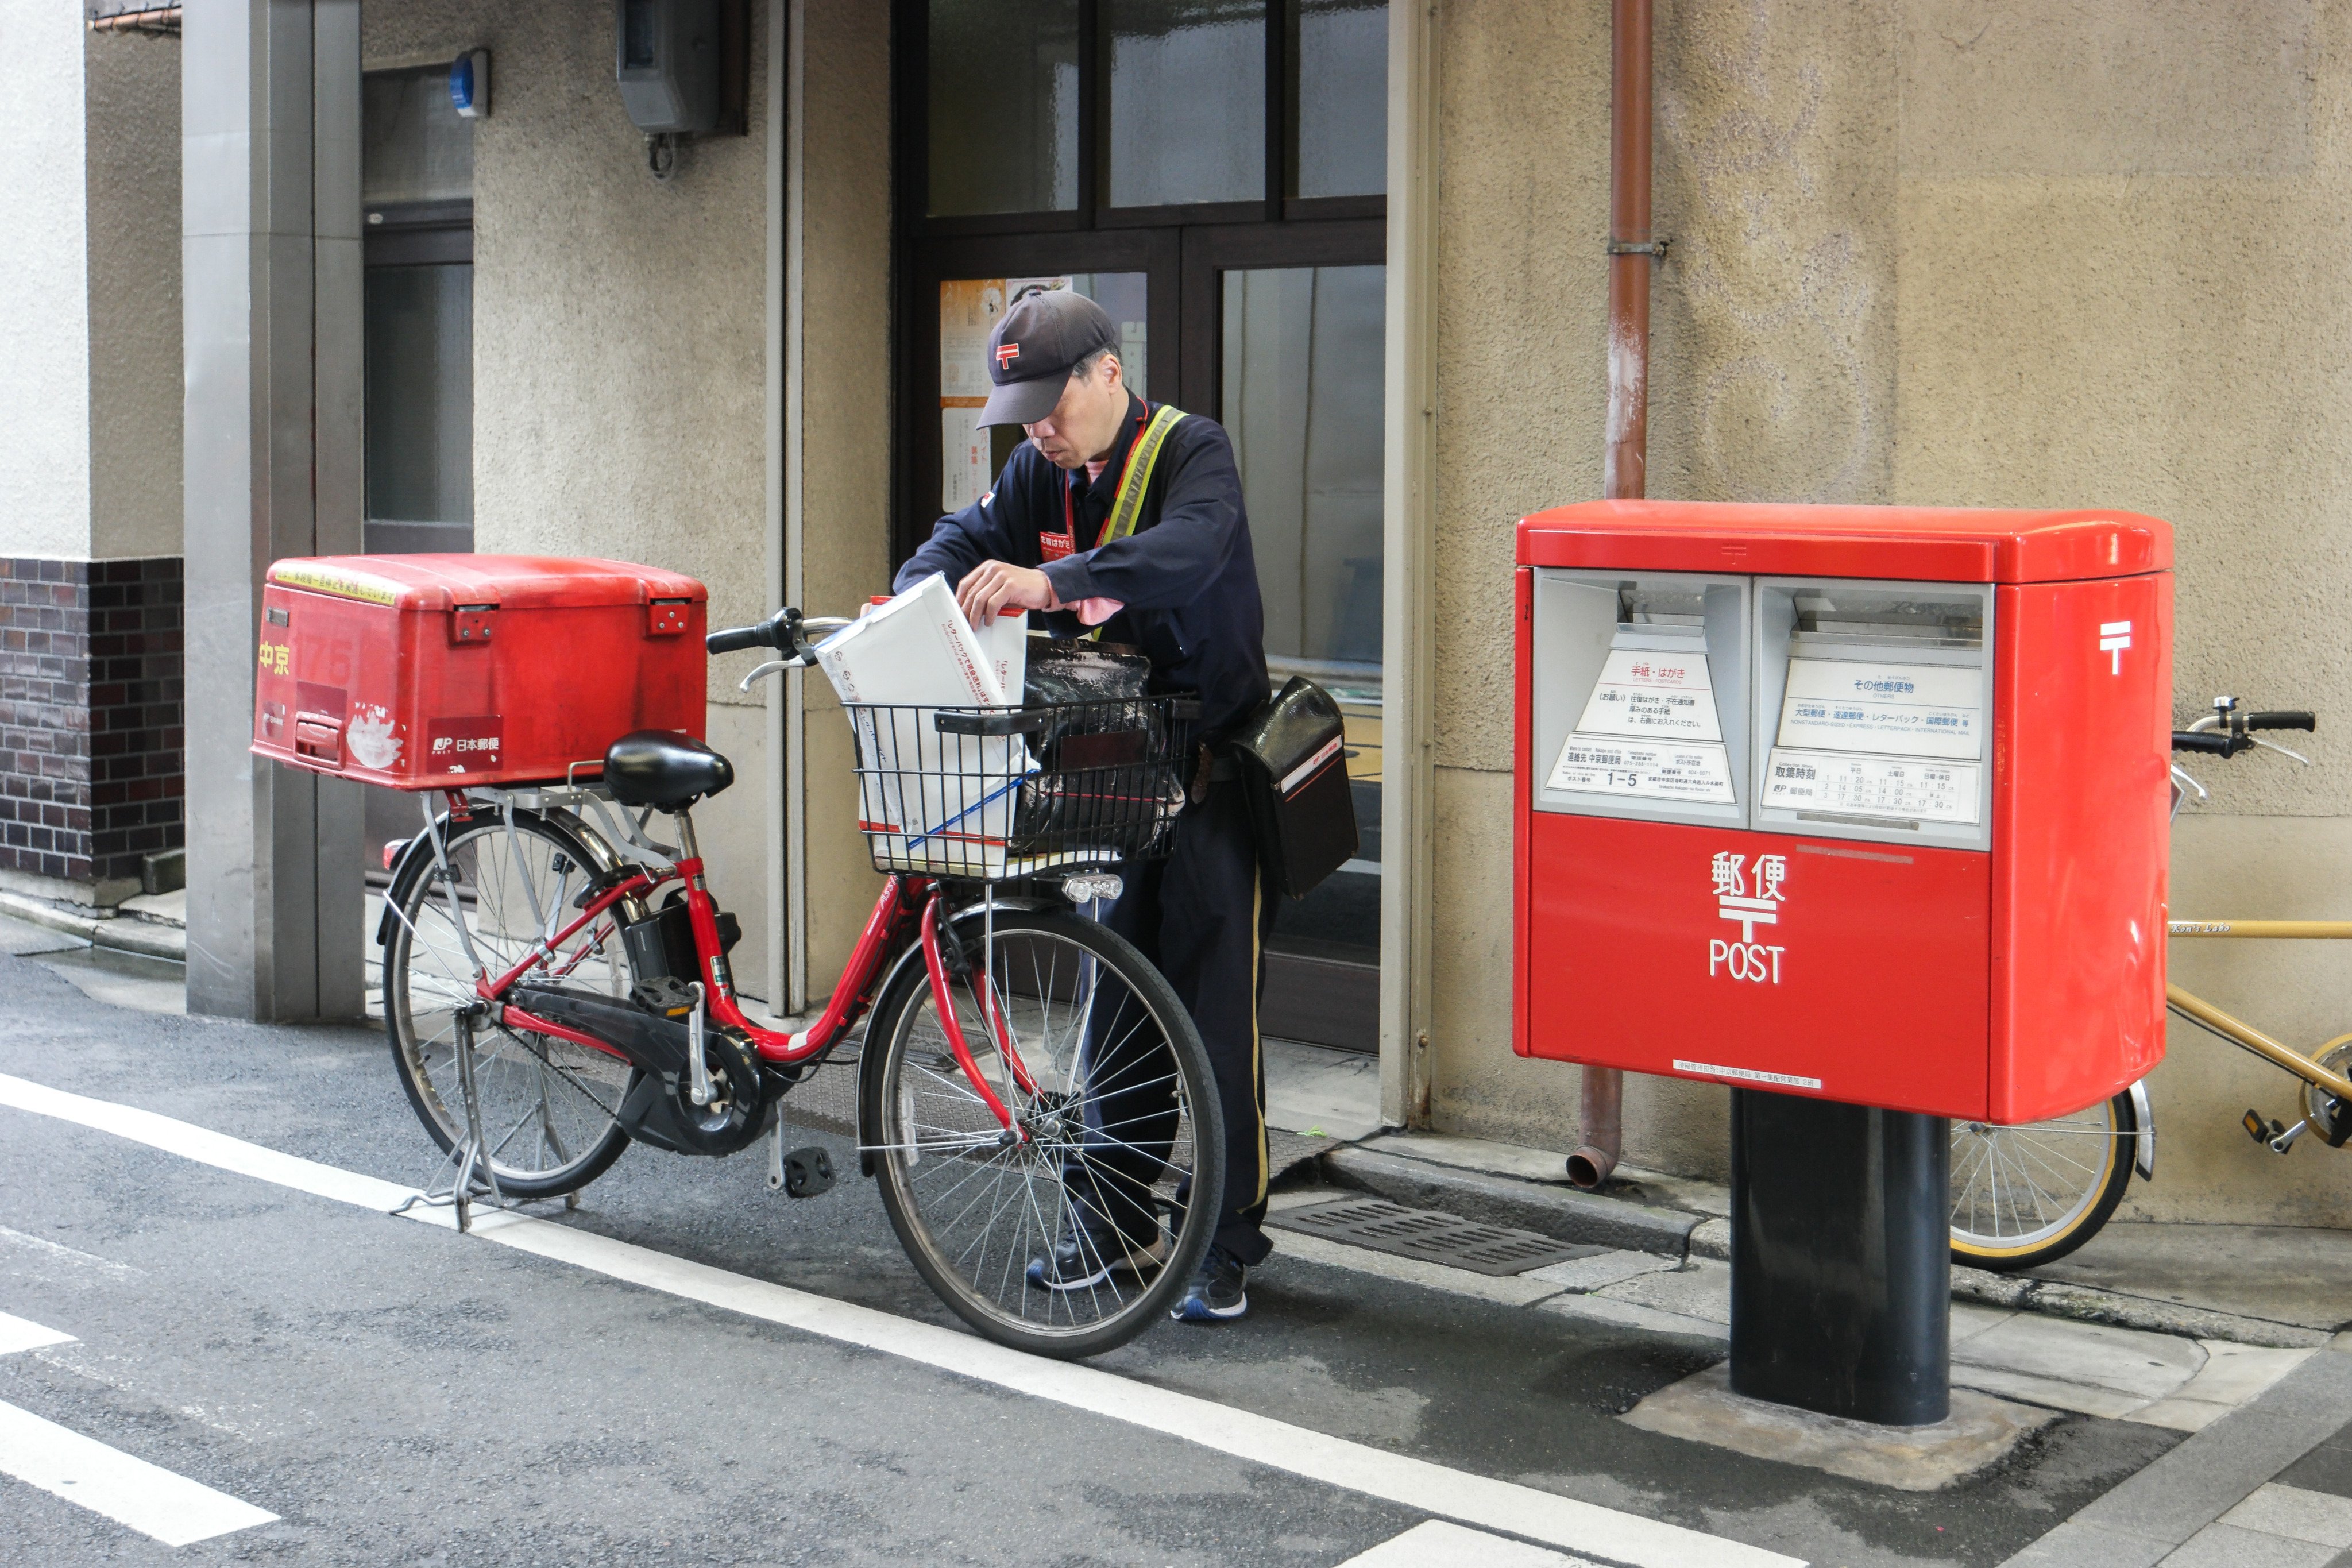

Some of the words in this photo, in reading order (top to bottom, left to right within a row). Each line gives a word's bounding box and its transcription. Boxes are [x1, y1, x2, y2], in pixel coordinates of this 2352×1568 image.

[260, 641, 289, 675] 中京
[1631, 666, 1685, 678] 手紙・はがき
[1854, 680, 1914, 693] その他郵便物
[1629, 706, 1671, 715] 厚みのある手紙
[1628, 717, 1701, 727] は、右側にお入れください。
[433, 737, 453, 750] JP
[457, 737, 499, 751] 日本郵便
[1567, 752, 1587, 763] 連絡先
[1589, 754, 1621, 765] 中京郵便局
[1608, 772, 1637, 787] 1-5
[1775, 766, 1816, 780] 取集時刻
[1790, 787, 1813, 796] 郵便局
[1710, 850, 1786, 901] 郵便
[2171, 924, 2201, 933] Kon's
[2203, 922, 2230, 932] Labo
[1709, 939, 1785, 984] POST
